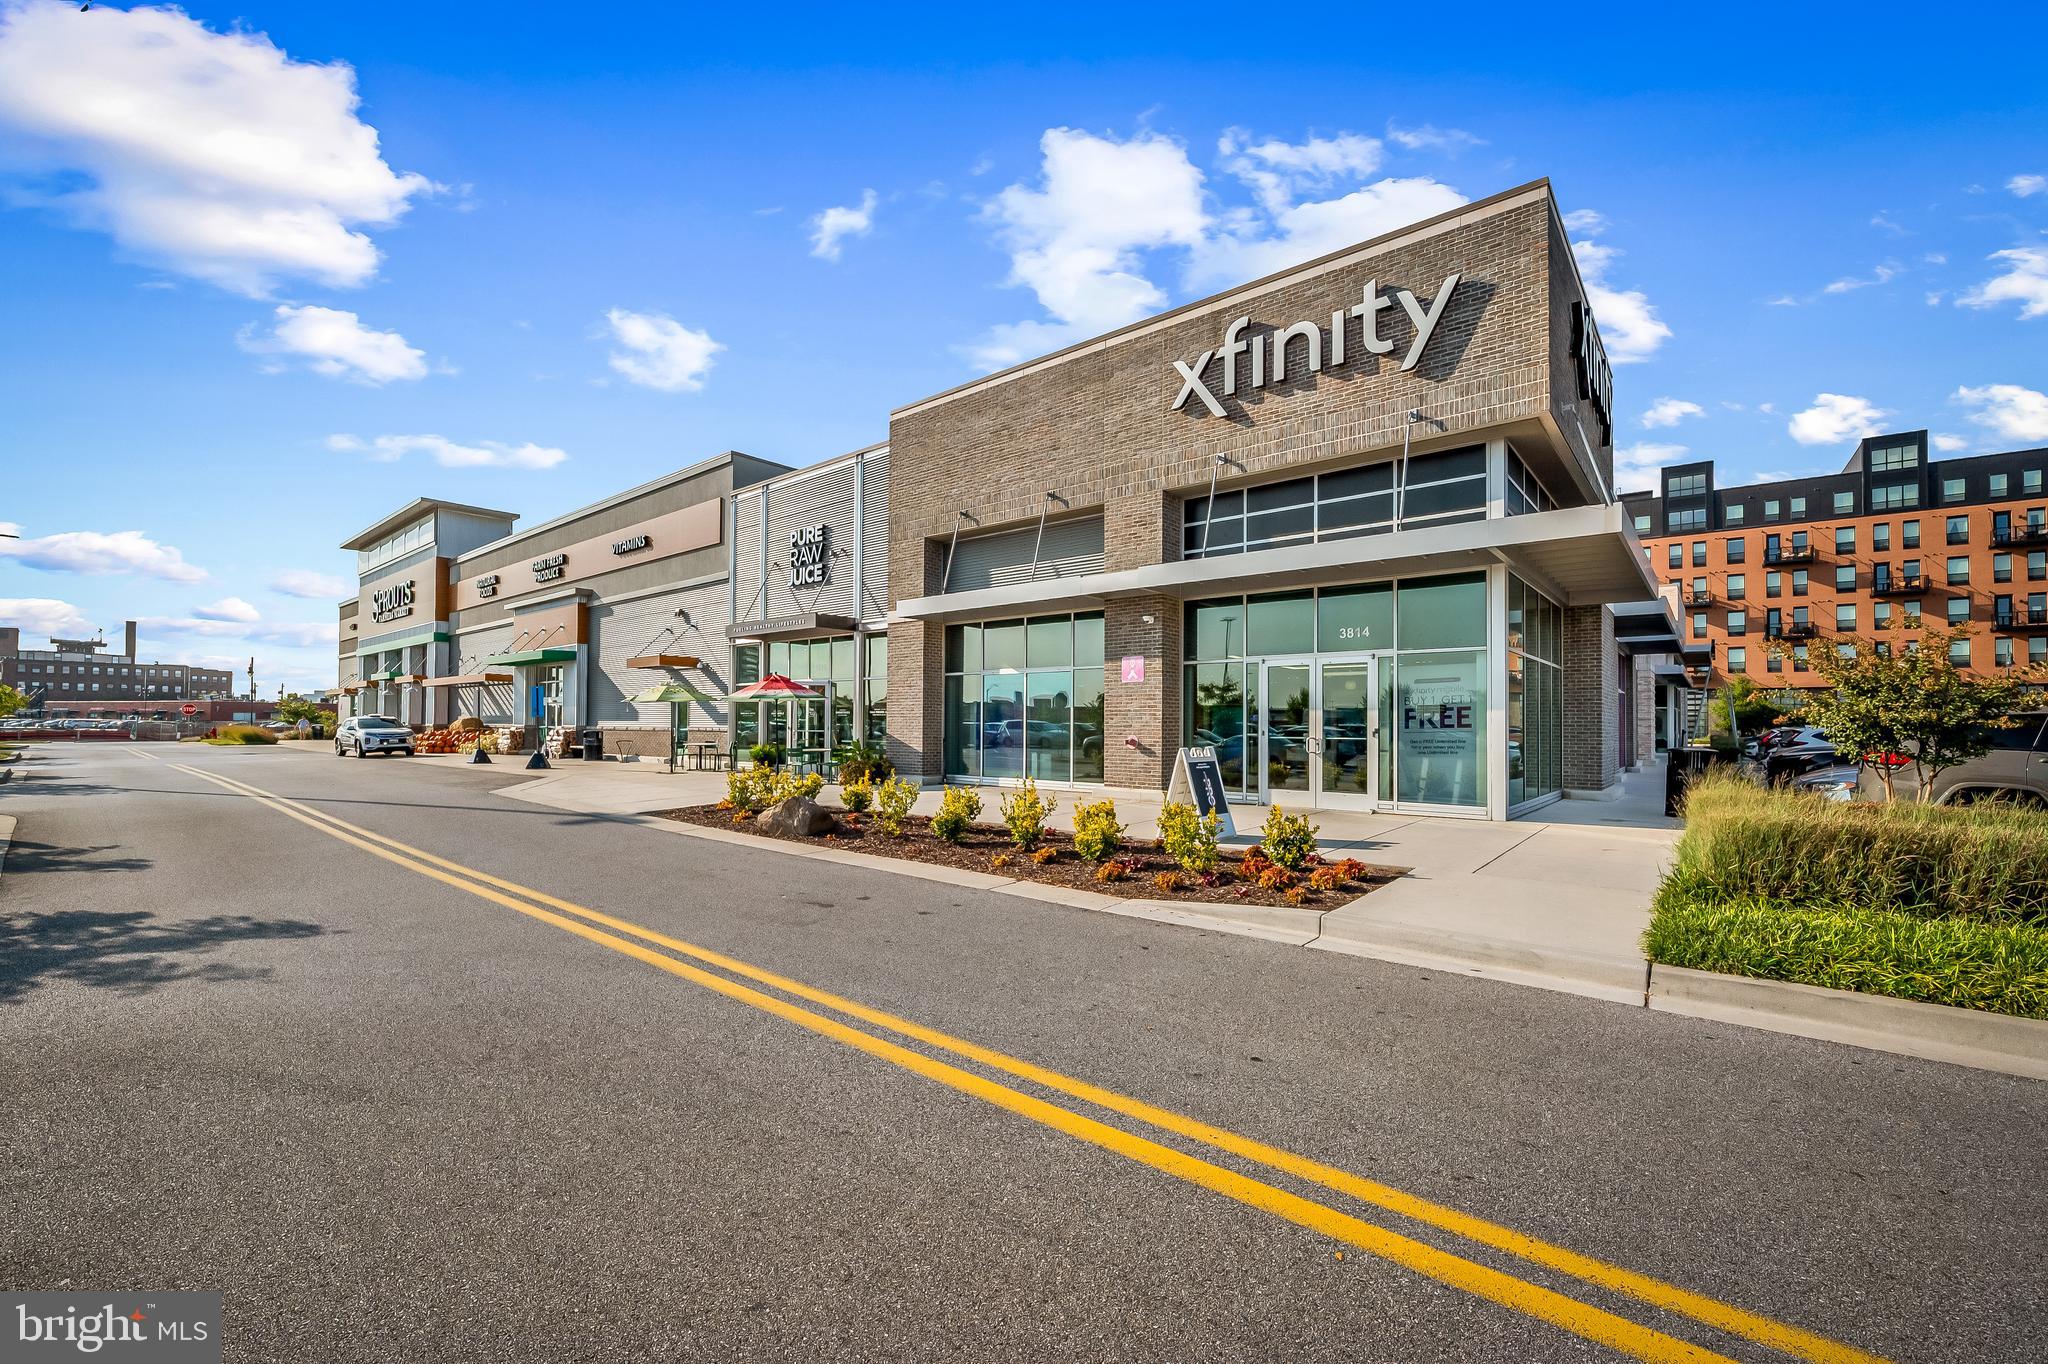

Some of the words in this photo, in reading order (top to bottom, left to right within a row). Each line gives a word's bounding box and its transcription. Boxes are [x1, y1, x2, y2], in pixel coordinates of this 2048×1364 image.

[1171, 273, 1462, 417] xfinity
[611, 535, 646, 555] VITAMINS
[789, 524, 824, 546] PURE
[546, 553, 563, 567] FRESH
[789, 542, 824, 568] RAW
[535, 566, 559, 582] PRODUCE
[787, 563, 824, 587] JUICE
[371, 579, 411, 623] SPROUTS
[1339, 626, 1370, 639] 3814
[1404, 695, 1427, 706] BUY
[1441, 694, 1465, 705] GET
[1404, 706, 1473, 729] FREE
